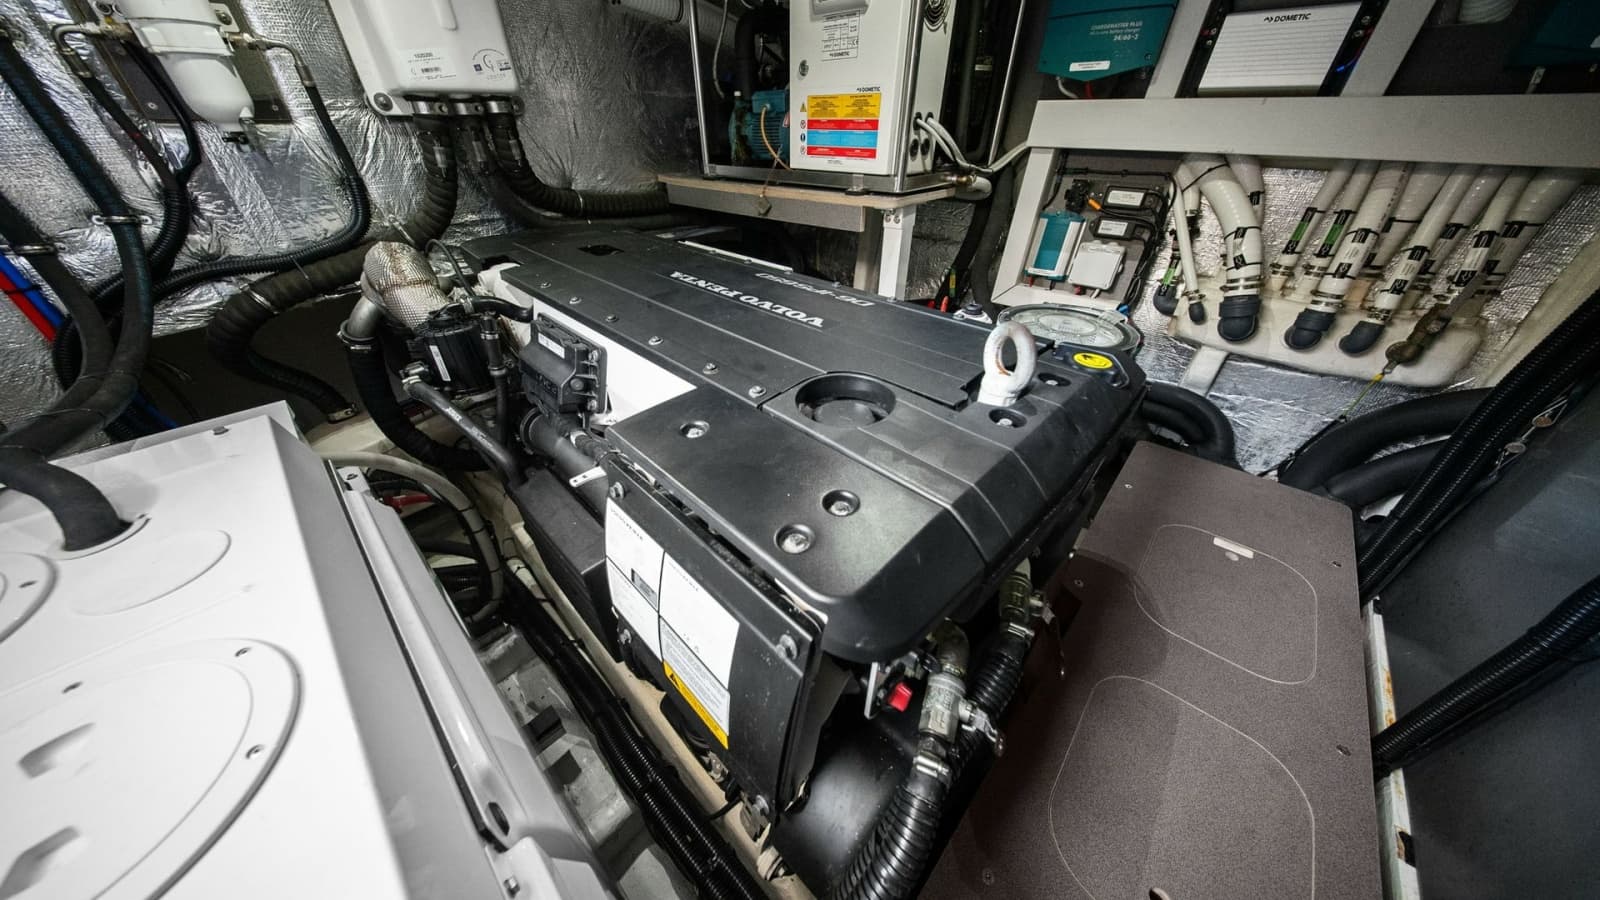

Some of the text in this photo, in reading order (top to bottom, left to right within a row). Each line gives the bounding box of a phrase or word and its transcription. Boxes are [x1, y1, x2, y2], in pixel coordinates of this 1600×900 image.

[1273, 13, 1311, 22] DOMETIC
[669, 270, 826, 328] VOLVO PENTA
